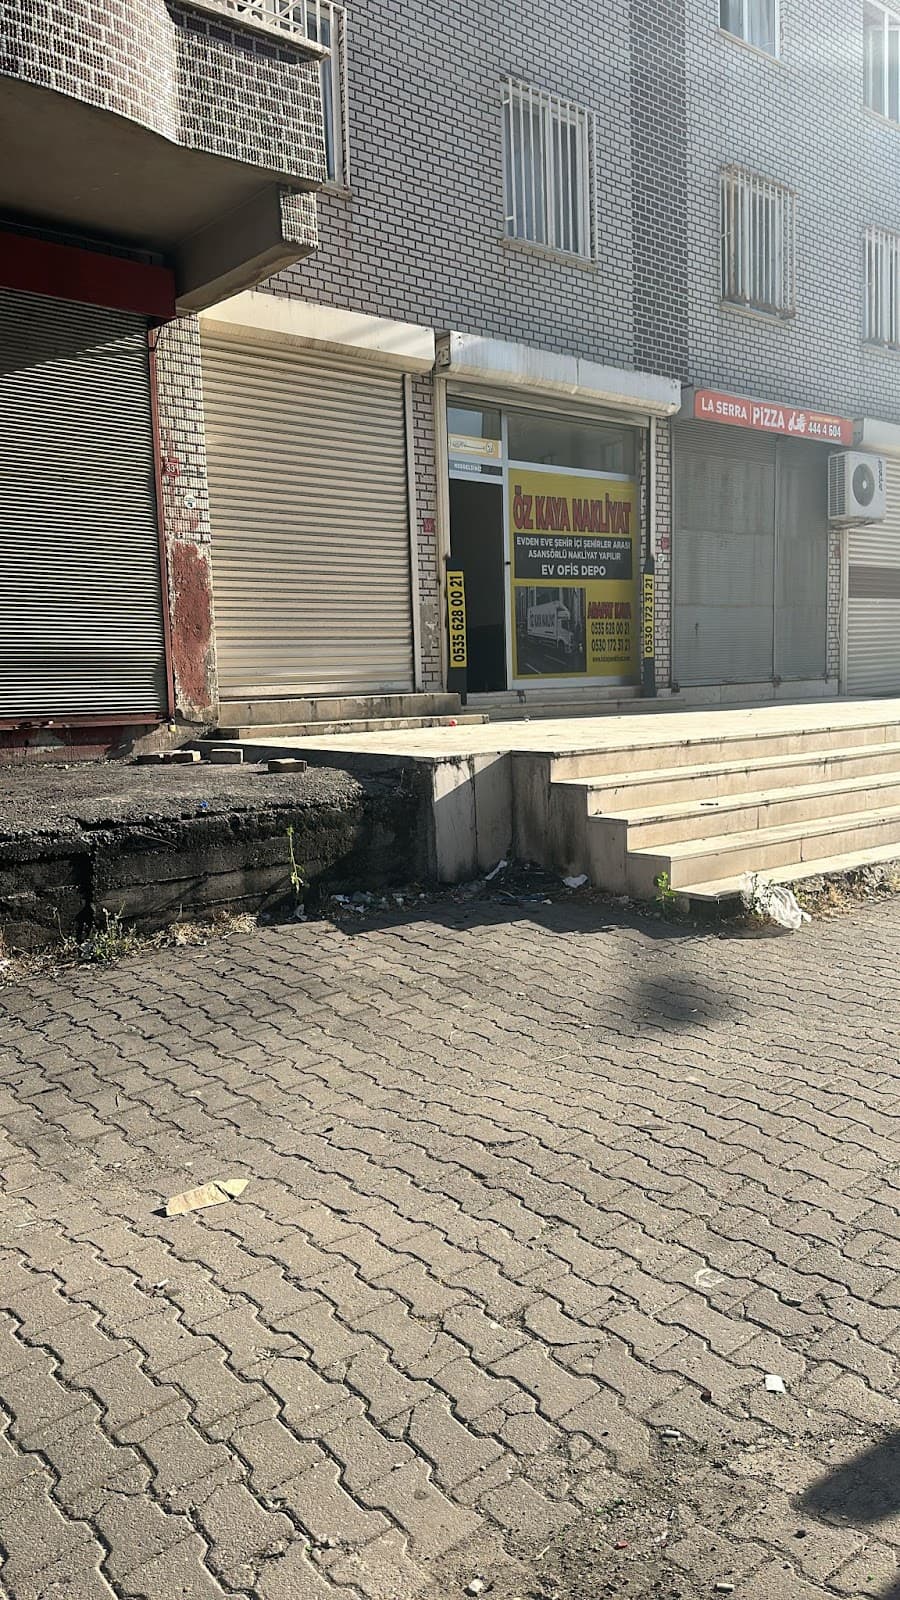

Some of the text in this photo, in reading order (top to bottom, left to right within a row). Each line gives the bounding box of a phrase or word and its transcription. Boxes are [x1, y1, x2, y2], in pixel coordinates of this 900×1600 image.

[701, 397, 714, 413] LA
[716, 401, 748, 420] SERRA
[808, 421, 821, 435] 444
[822, 423, 827, 436] 4
[513, 485, 632, 534] ÖZ KAYA NAKLİYAT
[516, 537, 631, 550] EVDEN EVE ŞEHİR İÇİ ŞEHİRLER ARASI
[528, 548, 622, 560] ASANSÖRLÜ NAKLİYAT YAPILIR
[541, 563, 607, 576] EV OFİS DEPO
[449, 576, 465, 662] 0535 628 00 21
[645, 578, 653, 653] 0530 172 31 21
